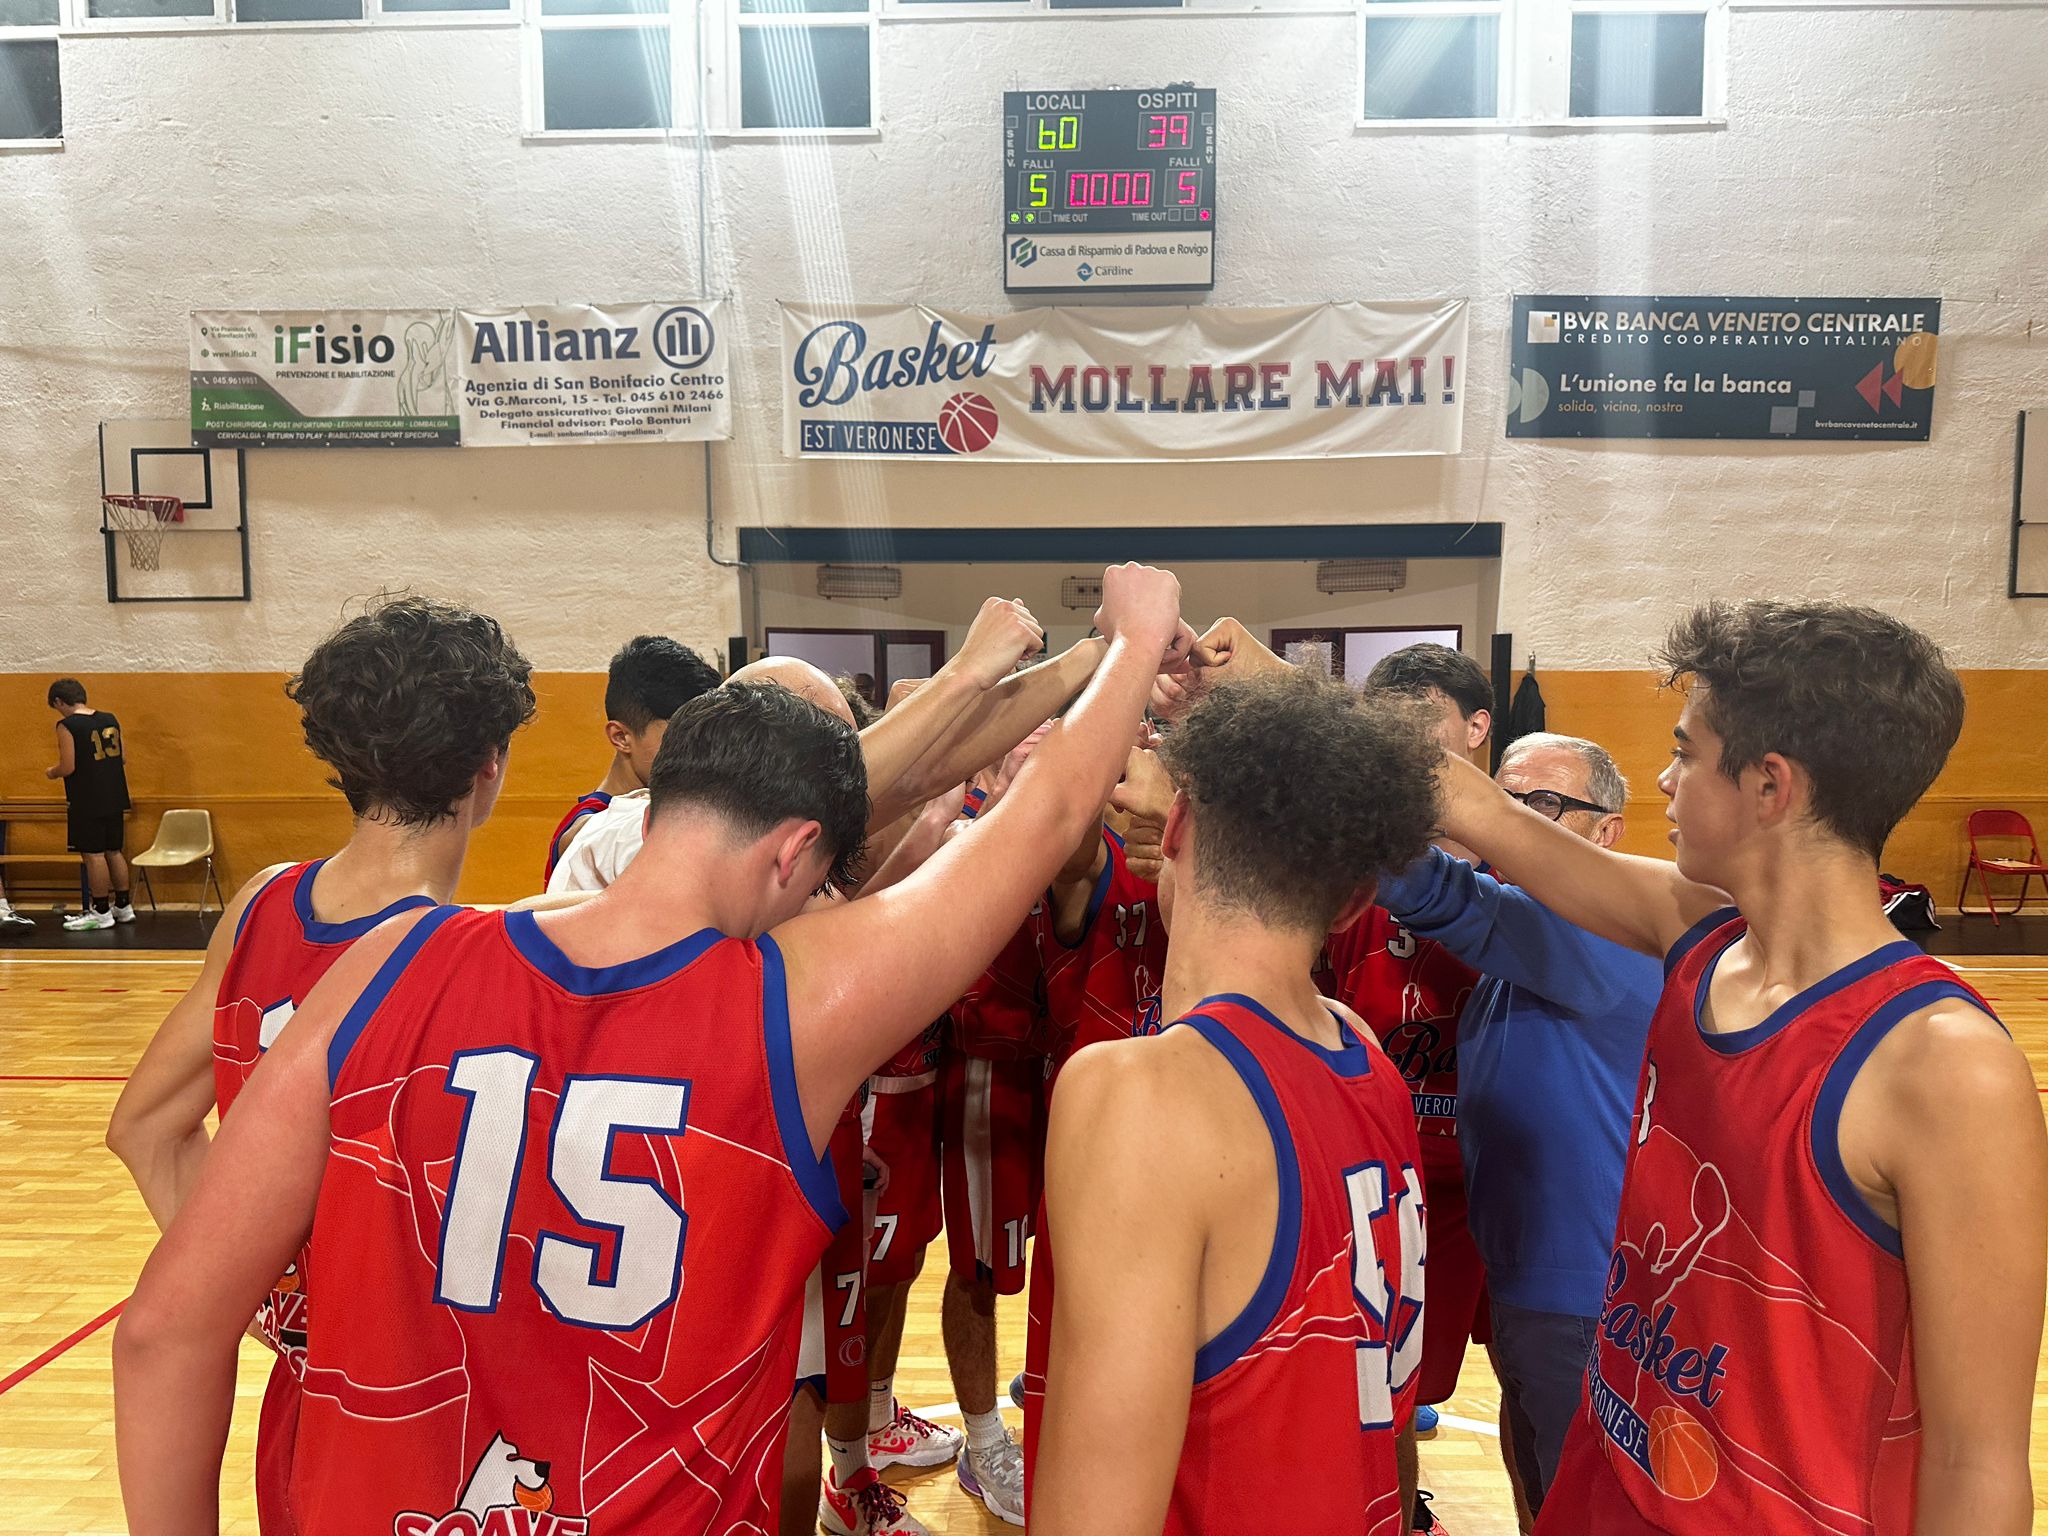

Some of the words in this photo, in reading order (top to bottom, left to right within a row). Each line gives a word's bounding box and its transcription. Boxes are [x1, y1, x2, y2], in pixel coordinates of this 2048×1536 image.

[1026, 95, 1086, 110] LOCALI
[1138, 93, 1197, 109] OSPITI
[1039, 117, 1077, 149] 60
[1149, 116, 1188, 148] 39
[1023, 160, 1053, 169] FALLI
[1169, 158, 1200, 167] FALLI
[1030, 174, 1047, 207] 5
[1070, 173, 1150, 206] 0000
[1178, 172, 1196, 204] 5
[1132, 213, 1149, 221] TIME
[1151, 212, 1167, 220] OUT
[1040, 246, 1065, 256] Cassa
[1067, 245, 1076, 256] di
[1078, 245, 1122, 258] Risparmio
[1124, 244, 1133, 255] di
[1135, 244, 1167, 255] Padova
[1169, 246, 1175, 254] e
[1177, 243, 1208, 256] Rovigo
[1095, 266, 1133, 276] Cardine
[1564, 311, 1609, 330] BVR
[1615, 312, 1700, 331] BANCA
[1707, 312, 1801, 332] VENETO
[1806, 313, 1924, 333] CENTRALE
[274, 324, 395, 364] iFisio
[471, 319, 641, 364] Allianz
[1564, 333, 1651, 345] CREDITO
[1663, 334, 1811, 346] COOPERATIVO
[1824, 335, 1922, 347] ITALIANO
[212, 350, 257, 358] www.ifisio.it
[793, 320, 997, 409] Basket
[338, 370, 395, 378] RIABILITAZIONE
[465, 379, 528, 395] Agenzia
[533, 377, 548, 390] di
[554, 377, 584, 390] San
[590, 375, 665, 389] Bonifacio
[670, 372, 725, 386] Centro
[1560, 373, 1657, 393] L'unione
[1663, 374, 1688, 393] fa
[1694, 373, 1715, 393] la
[1721, 374, 1791, 394] banca
[1028, 361, 1292, 413] MOLLARE
[214, 402, 264, 411] Riabilitazione
[467, 397, 489, 406] Via
[494, 395, 566, 406] G.Marconi,
[572, 395, 588, 404] 15
[603, 394, 626, 404] Tel.
[631, 392, 654, 402] 045
[660, 391, 685, 401] 610
[690, 390, 724, 400] 2466
[1558, 399, 1598, 415] solida,
[1602, 399, 1642, 415] vicina,
[1646, 401, 1683, 413] nostra
[480, 409, 533, 419] Delegato
[537, 407, 612, 417] assicurativo:
[616, 405, 669, 414] Giovanni
[673, 404, 712, 413] Milani
[501, 420, 554, 429] Financial
[557, 418, 606, 428] advisor:
[610, 418, 643, 427] Paolo
[647, 416, 691, 425] Bonturi
[217, 432, 261, 440] CERVICALGIA
[405, 431, 439, 439] SPECIFICA
[529, 431, 555, 439] E-mail:
[804, 425, 836, 449] EST
[844, 426, 937, 451] VERONESE
[91, 727, 121, 761] 13
[1115, 900, 1147, 949] 37
[432, 1043, 693, 1334] 15
[872, 1213, 899, 1262] 7
[835, 1269, 862, 1328] 7
